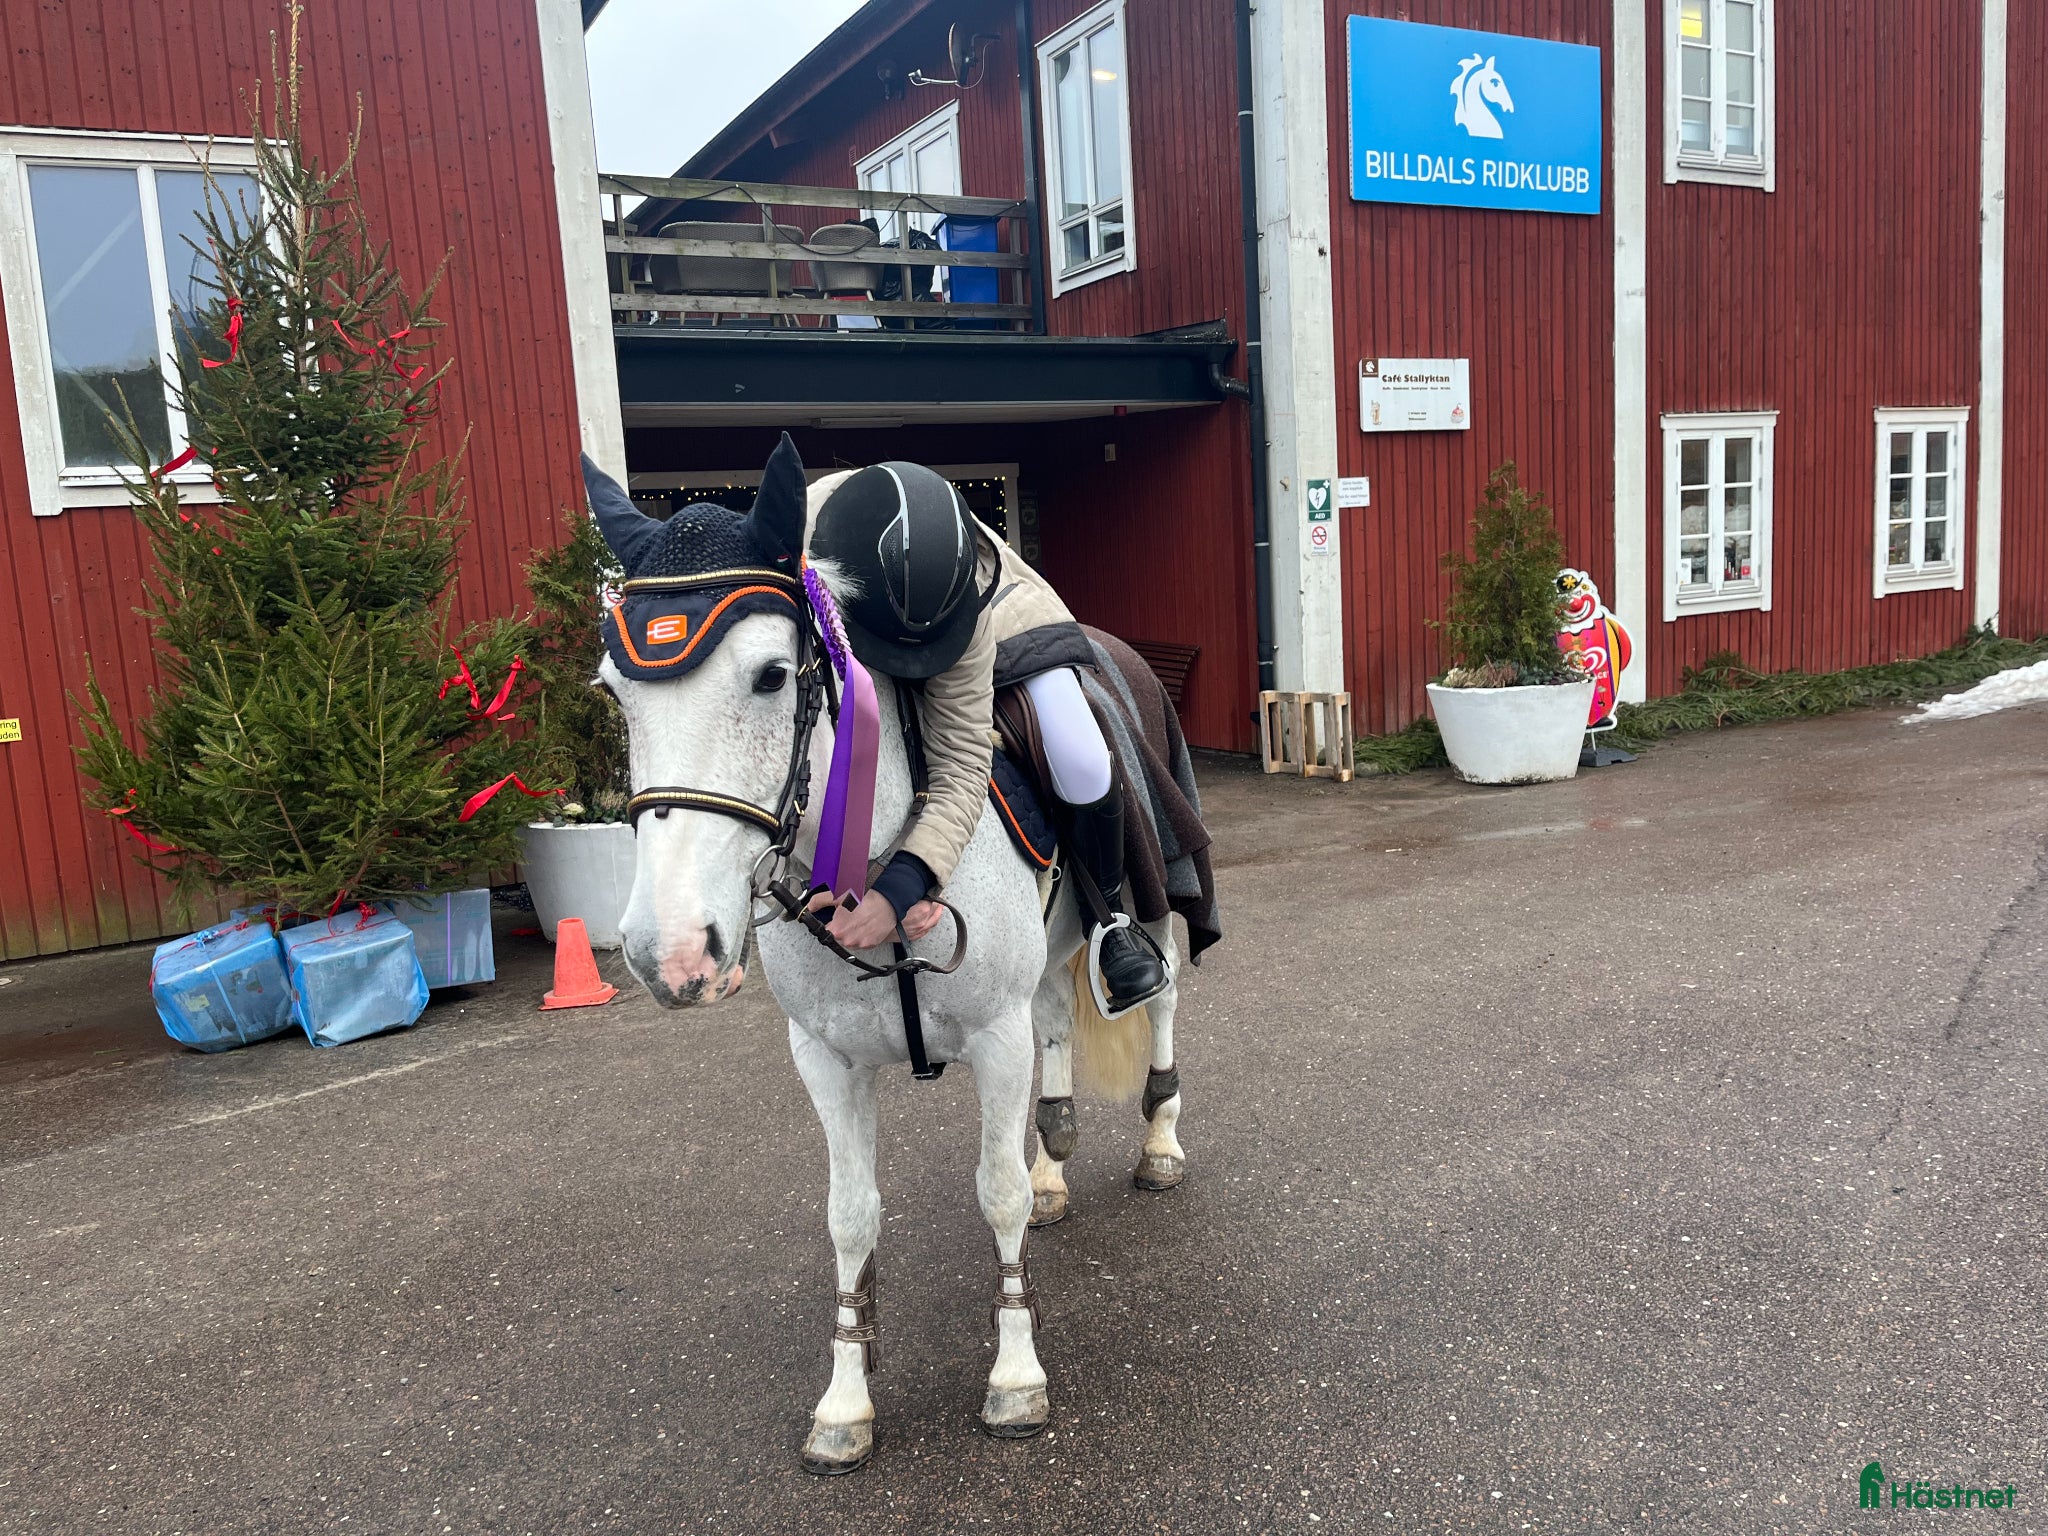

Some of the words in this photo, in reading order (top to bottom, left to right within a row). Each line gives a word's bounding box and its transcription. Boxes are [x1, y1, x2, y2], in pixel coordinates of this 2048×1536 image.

[1365, 150, 1475, 185] BILLDALS
[1483, 159, 1590, 194] RIDKLUBB
[1382, 374, 1402, 382] Café
[1404, 374, 1450, 384] Stallyktan
